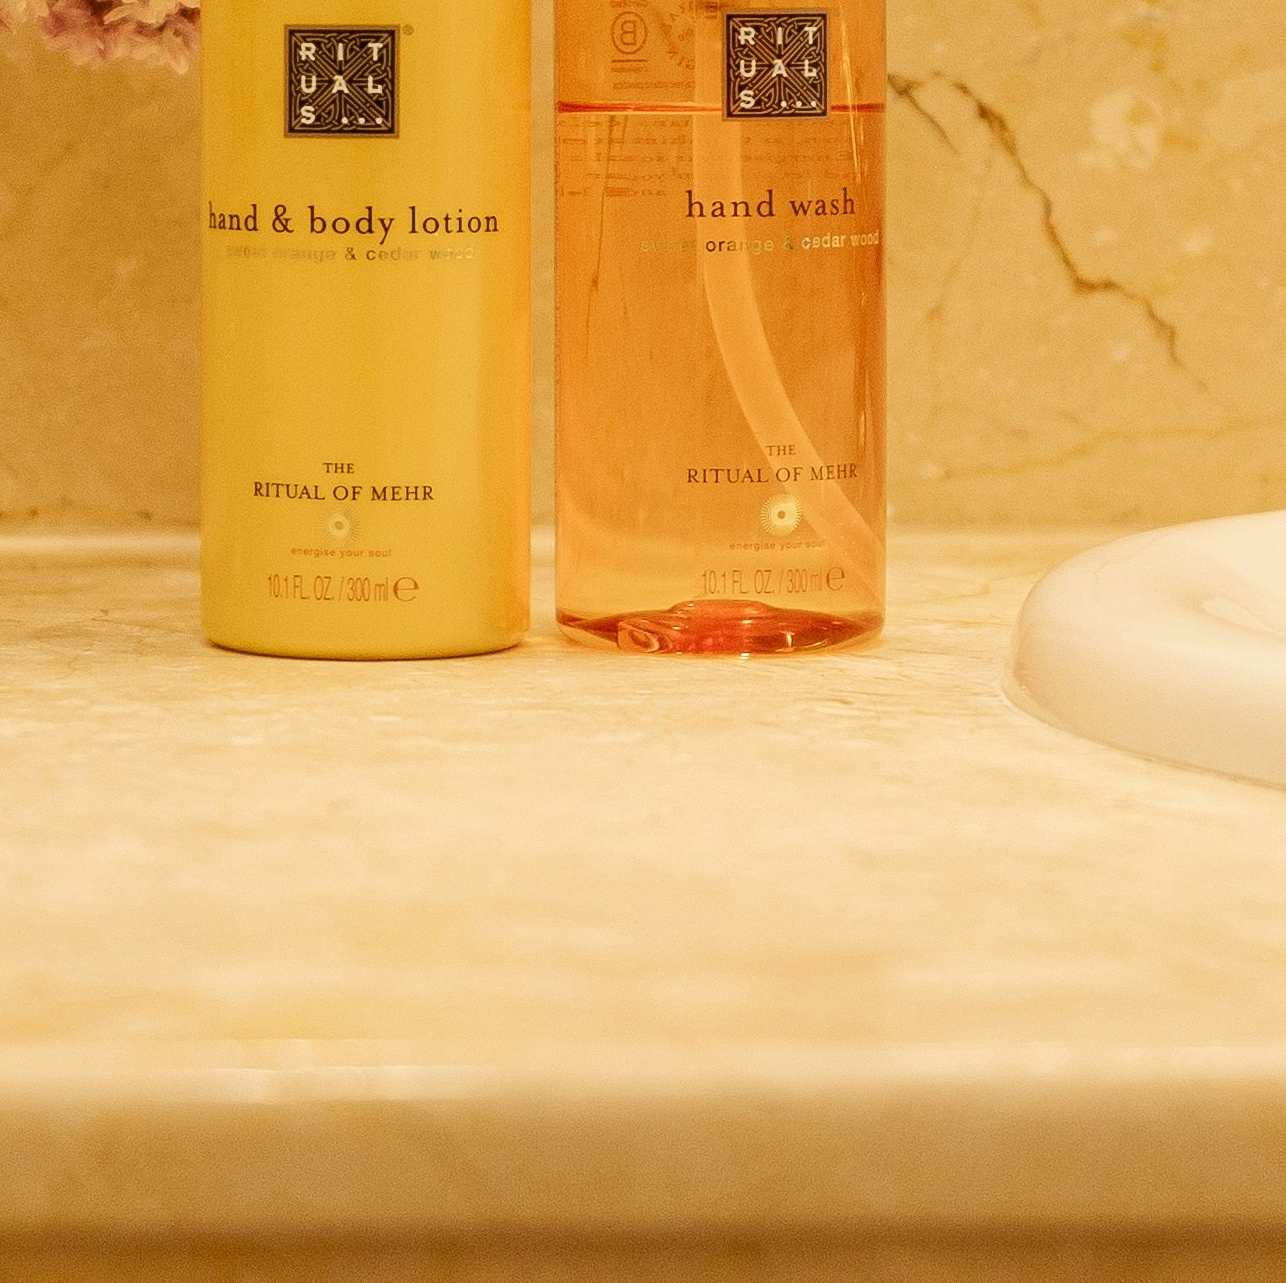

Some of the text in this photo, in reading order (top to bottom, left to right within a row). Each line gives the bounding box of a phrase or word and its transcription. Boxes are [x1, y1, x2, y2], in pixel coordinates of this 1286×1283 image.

[685, 187, 856, 218] hand wash
[208, 201, 499, 245] hand & body lotion
[344, 247, 357, 261] &
[365, 246, 422, 261] cedar
[705, 239, 775, 255] orange
[801, 231, 847, 250] cedar
[849, 229, 880, 247] wood
[766, 444, 797, 456] THE
[323, 462, 355, 474] THE
[687, 463, 858, 484] RITUAL OF MEHR
[253, 481, 434, 501] RITUAL OF MEHR
[267, 574, 289, 599] 10.1
[346, 576, 371, 602] 300
[786, 568, 809, 594] 300
